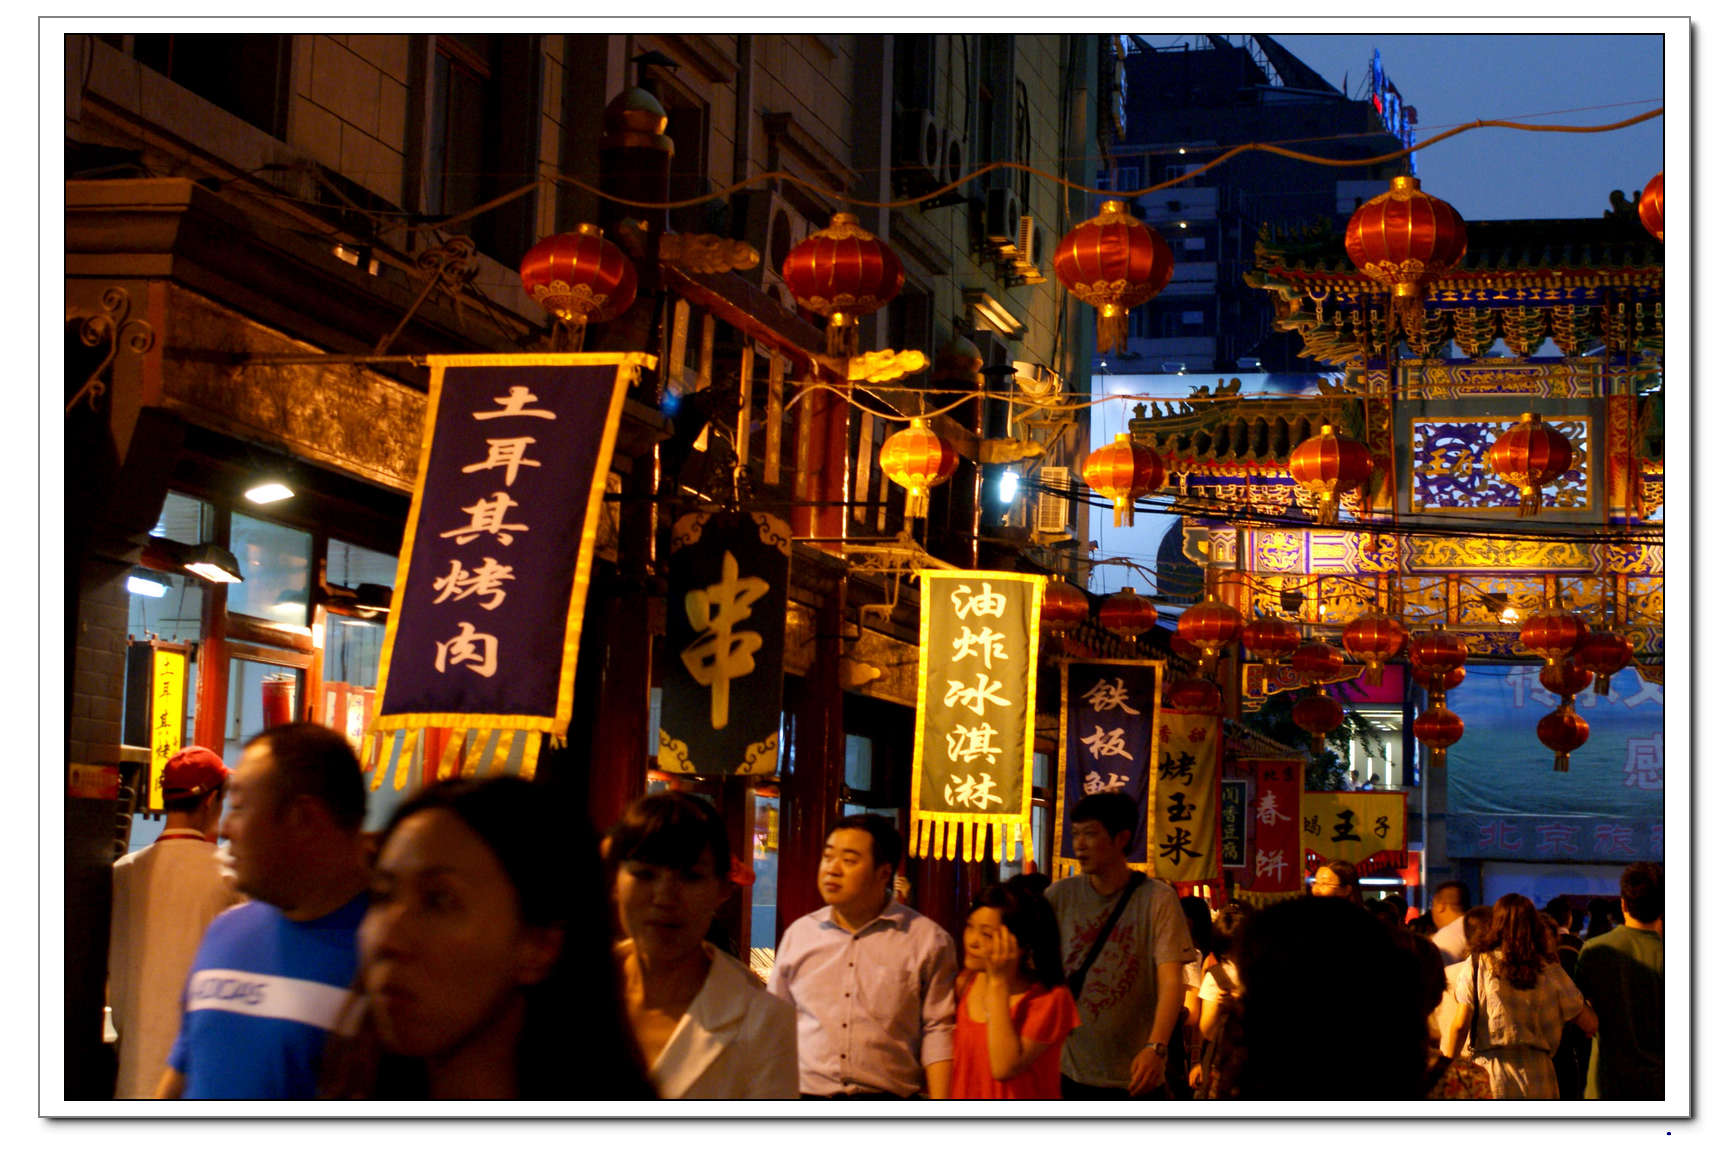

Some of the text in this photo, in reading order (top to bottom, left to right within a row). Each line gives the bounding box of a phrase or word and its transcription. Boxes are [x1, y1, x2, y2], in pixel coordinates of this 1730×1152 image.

[434, 387, 556, 678] 土耳其烤肉
[682, 552, 770, 729] 串
[943, 582, 1013, 809] 油炸冰淇淋
[1158, 751, 1203, 866] 烤玉米
[1256, 790, 1292, 885] 春饼
